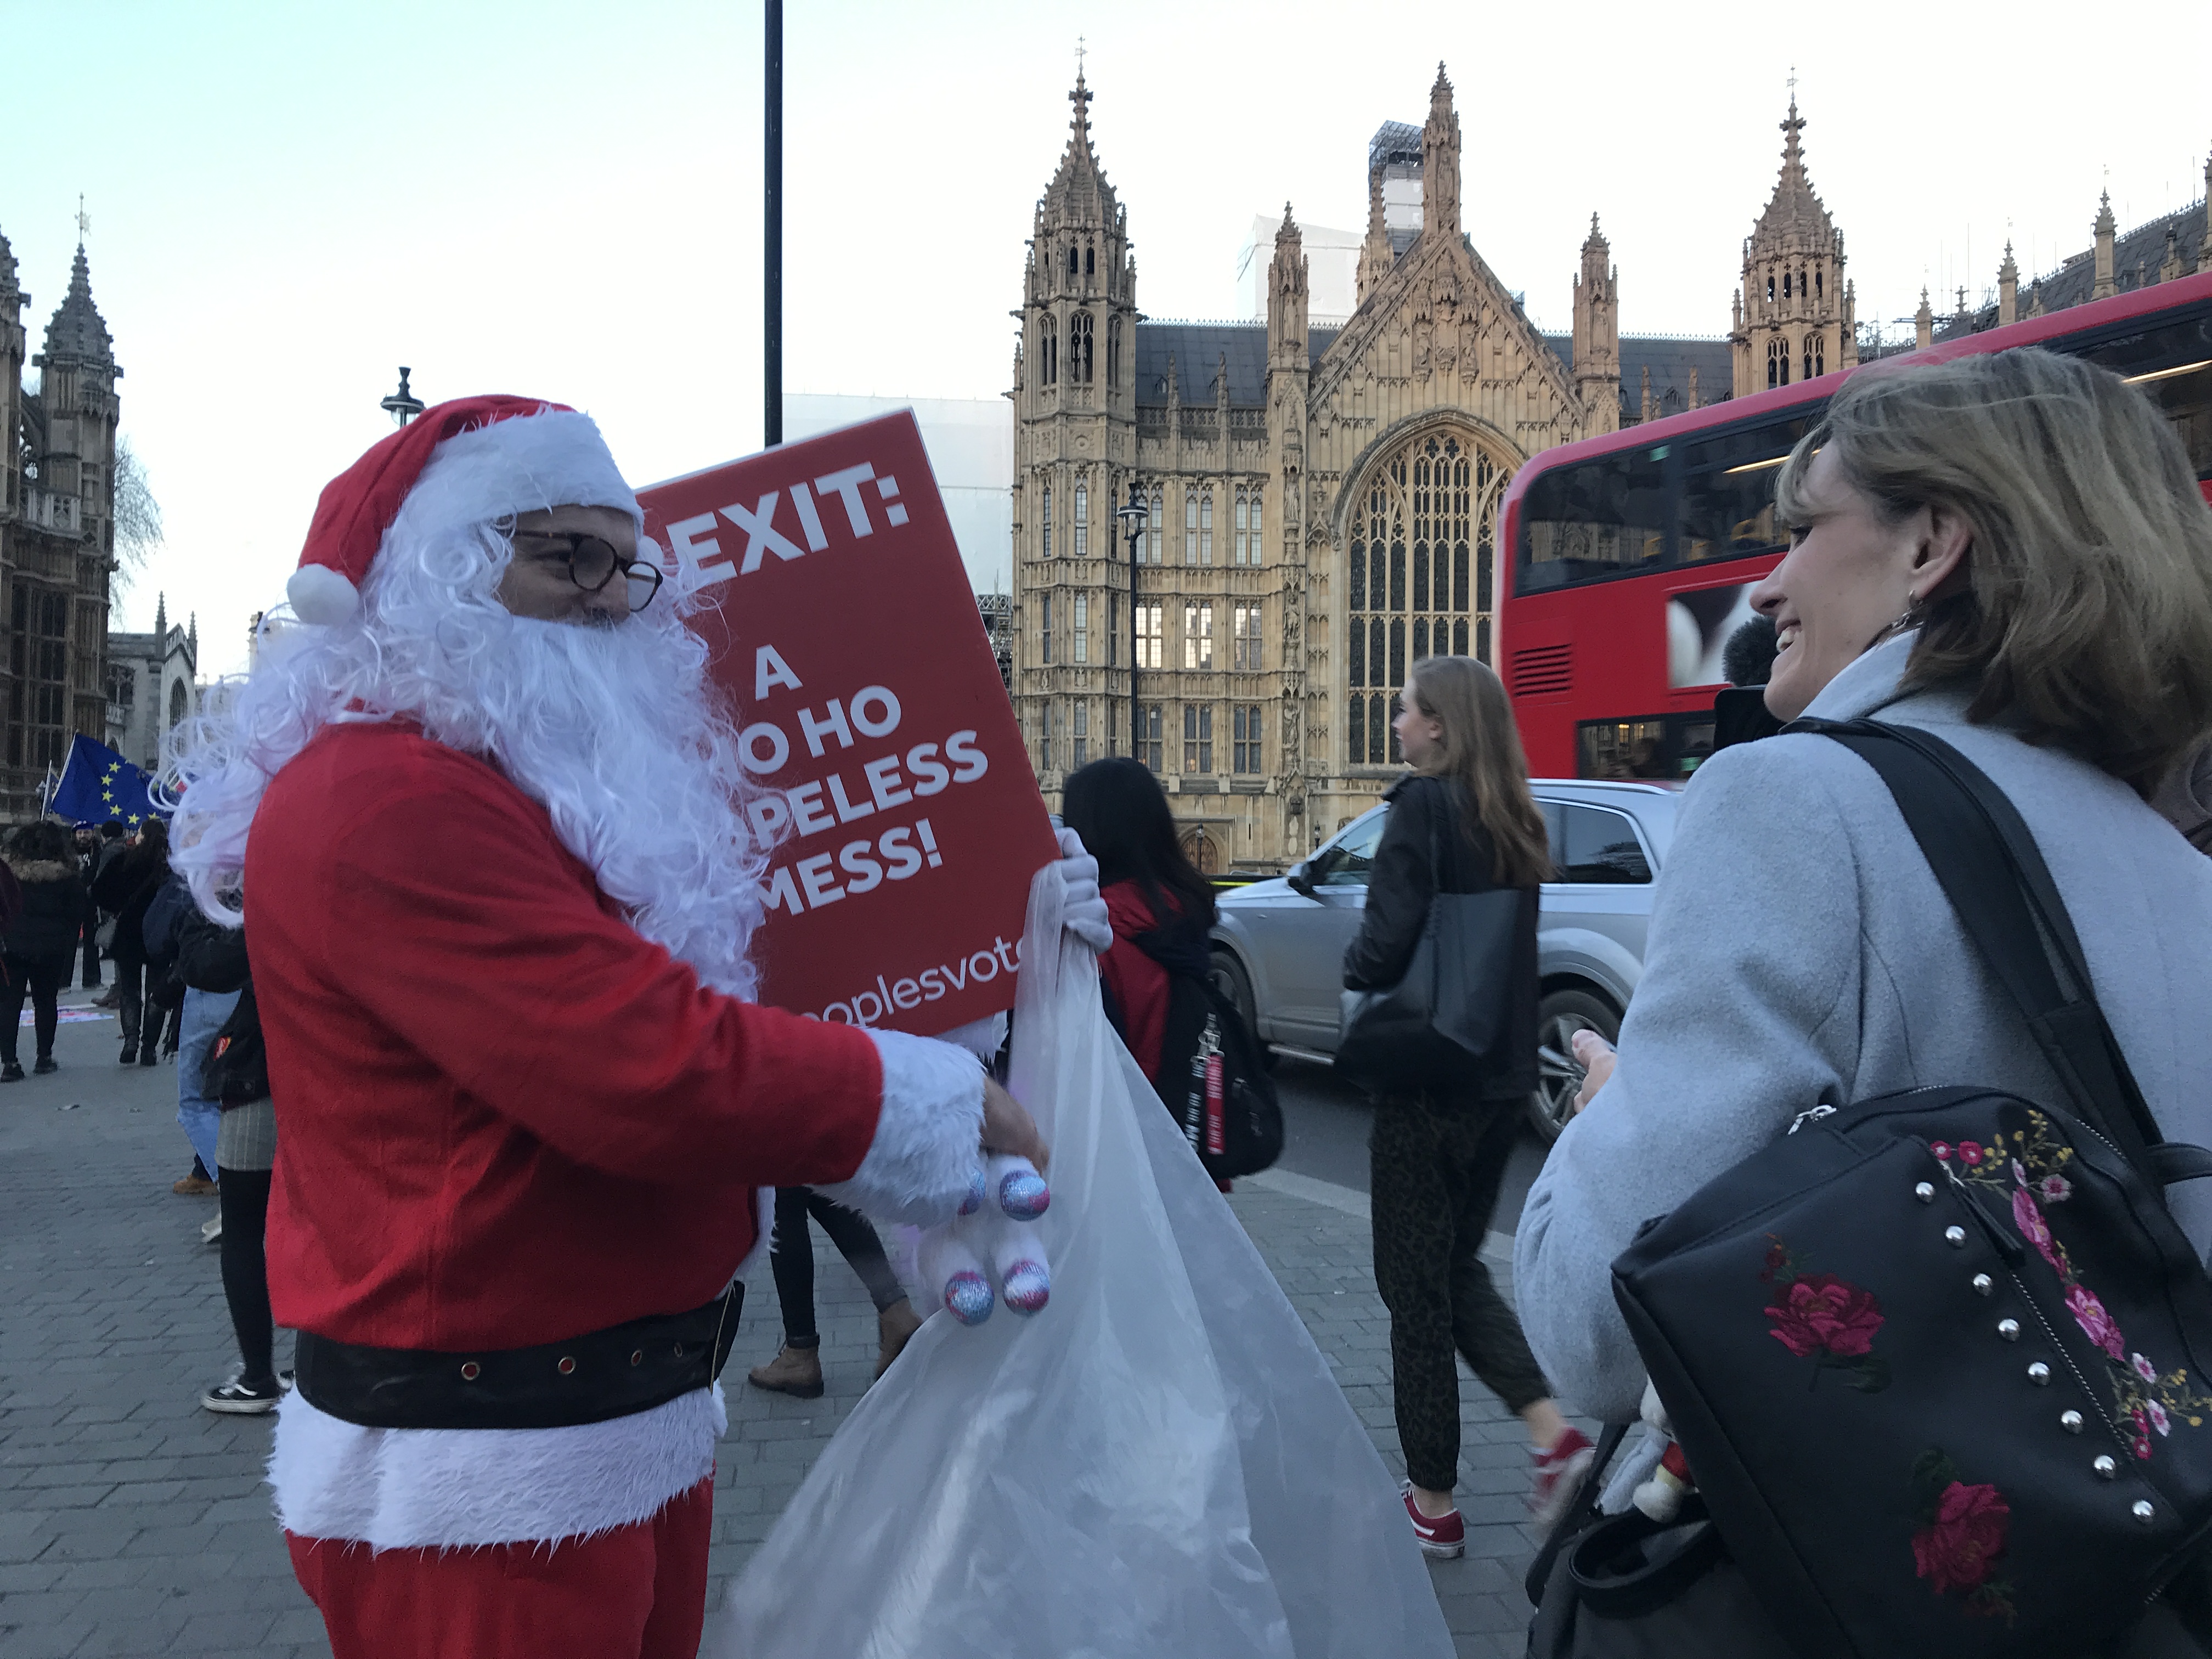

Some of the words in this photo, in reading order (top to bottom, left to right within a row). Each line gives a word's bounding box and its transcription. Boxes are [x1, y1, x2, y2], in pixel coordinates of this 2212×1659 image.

[665, 461, 910, 591] EXIT:
[755, 644, 803, 701] A
[797, 685, 901, 758] HO
[747, 730, 988, 850] PELESS
[802, 935, 1023, 1026] oplesvot
